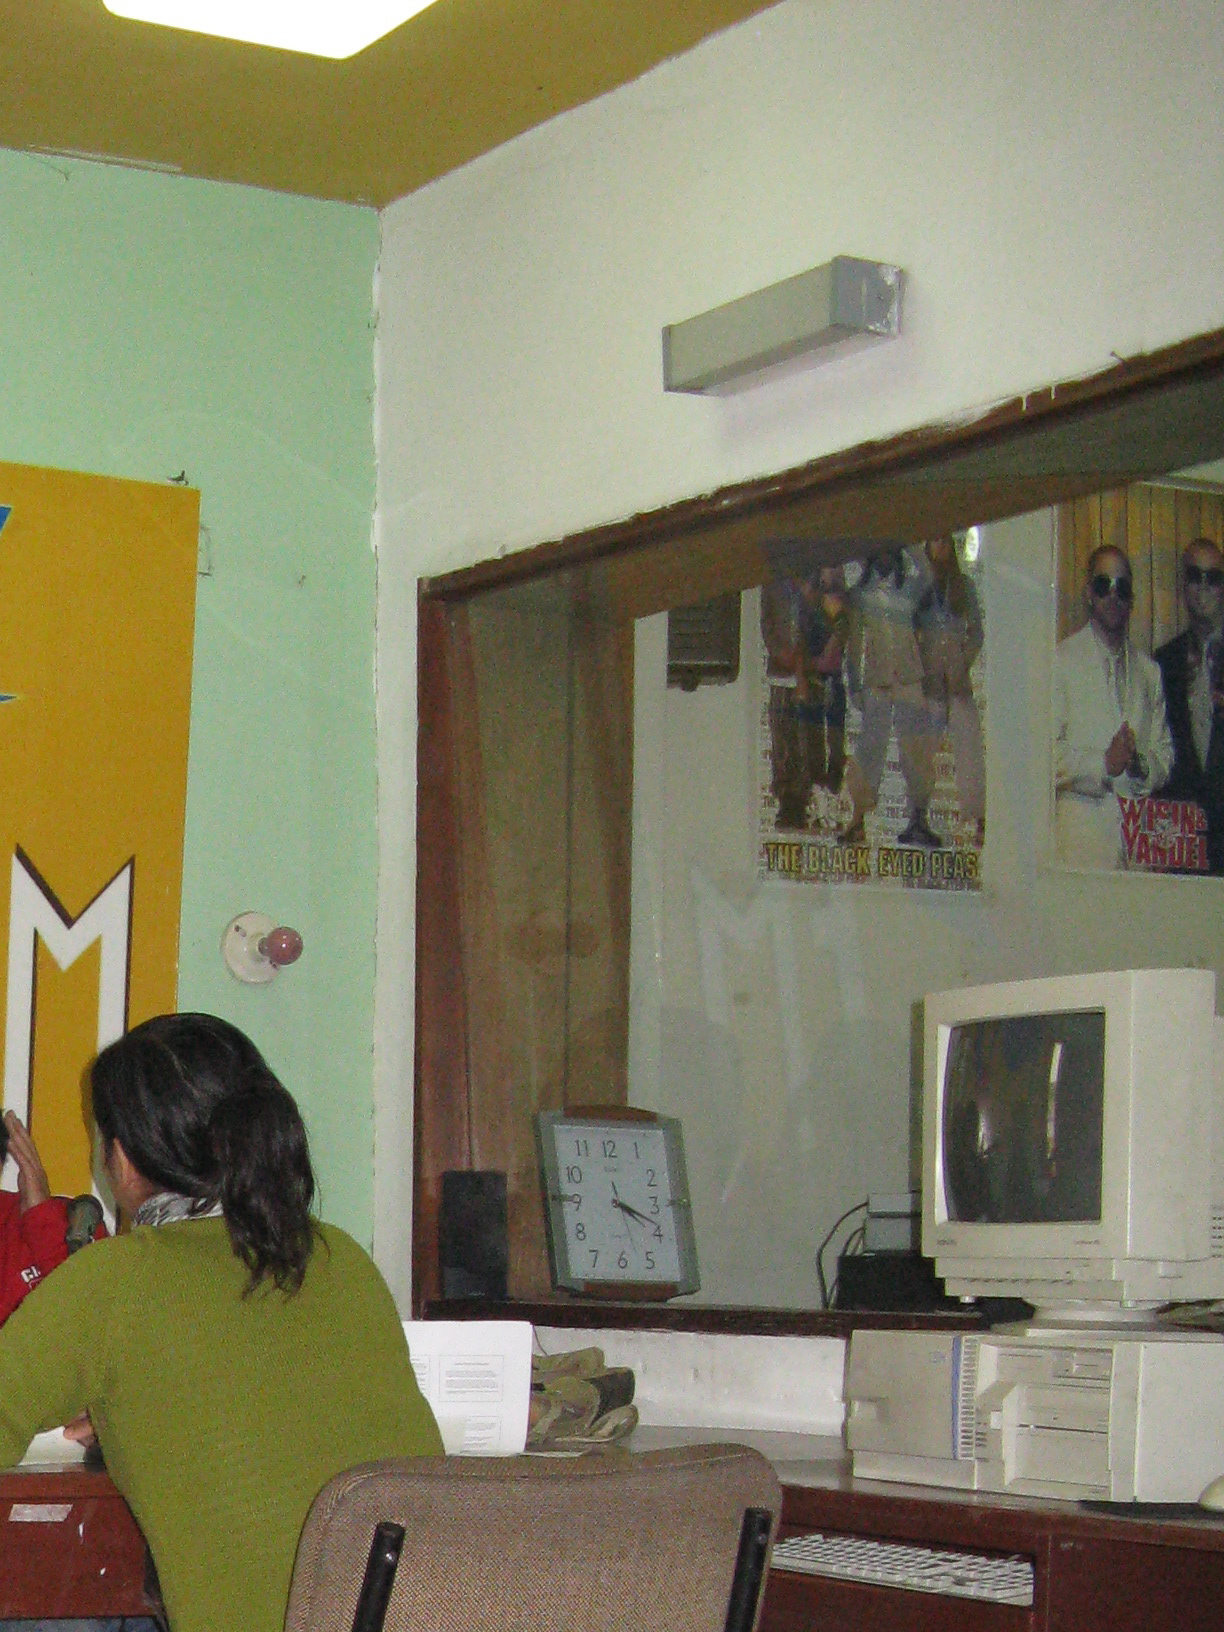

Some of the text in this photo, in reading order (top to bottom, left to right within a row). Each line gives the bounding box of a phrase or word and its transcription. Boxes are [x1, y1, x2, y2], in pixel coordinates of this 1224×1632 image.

[764, 842, 981, 880] THE BLACK EYED PEAS
[575, 1139, 589, 1157] 11
[602, 1140, 618, 1158] 12
[566, 1165, 657, 1187] 10 2
[572, 1193, 660, 1214] 9 3
[576, 1222, 663, 1244] 8 4
[589, 1249, 655, 1269] 7 6 5
